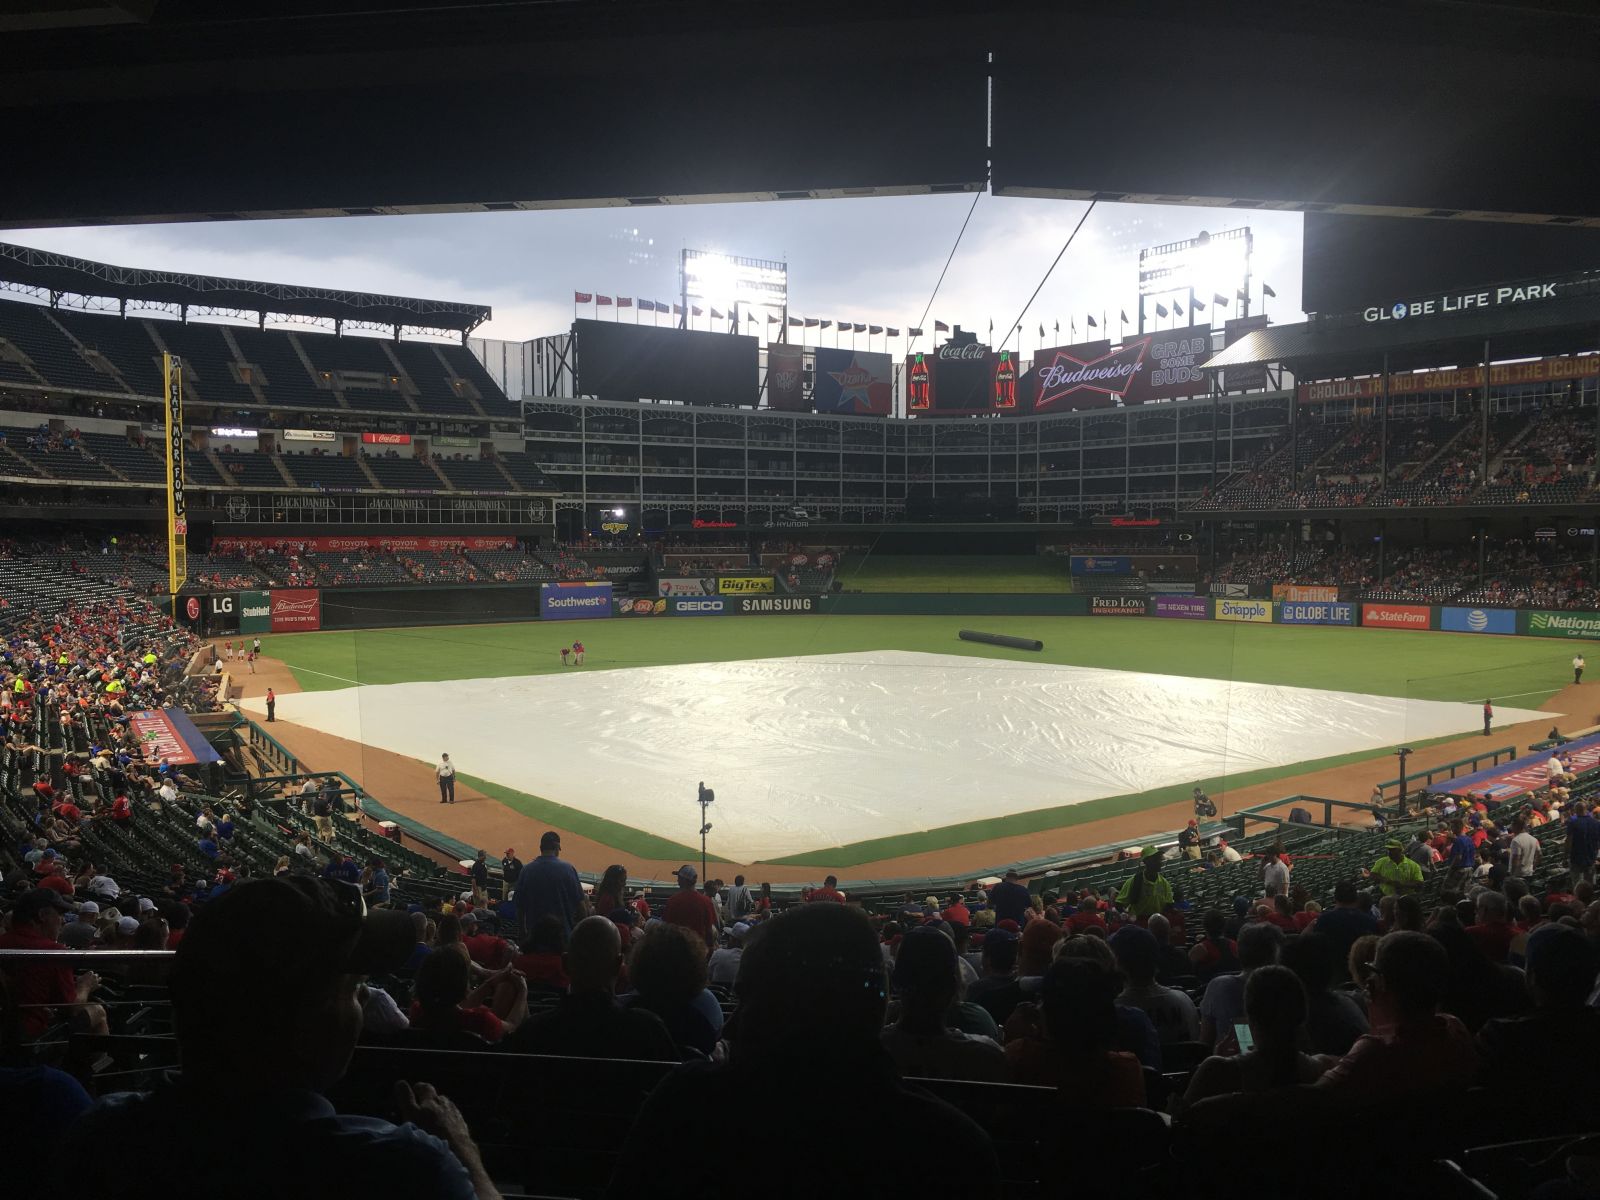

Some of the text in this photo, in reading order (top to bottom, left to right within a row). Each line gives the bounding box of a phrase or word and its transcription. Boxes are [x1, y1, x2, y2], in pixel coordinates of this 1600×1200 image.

[1363, 283, 1557, 322] GLOBE LIFE PARK
[1151, 338, 1205, 359] GRAB
[1160, 354, 1195, 368] SOME
[1039, 360, 1143, 388] Budweiser
[1151, 366, 1204, 386] BUDS
[1309, 382, 1362, 400] CHOLULA
[1395, 376, 1419, 392] HOT
[1424, 371, 1469, 389] SAUCE
[1474, 367, 1510, 384] WTH
[1515, 363, 1544, 379] THE
[171, 385, 179, 419] EAT
[172, 426, 181, 461] MOR
[174, 468, 184, 515] FOWL
[277, 497, 299, 507] JACK
[370, 498, 391, 508] JACK
[455, 499, 475, 509] JACK
[213, 597, 232, 614] LG
[277, 601, 312, 612] Budweiser
[548, 596, 600, 608] Southwest
[676, 601, 724, 611] GEICO
[742, 599, 811, 611] SAMSUNG
[1092, 597, 1118, 607] FRED
[243, 606, 270, 618] StubHub!
[1221, 602, 1265, 618] Snapple
[1295, 606, 1350, 620] GLOBE LIFE
